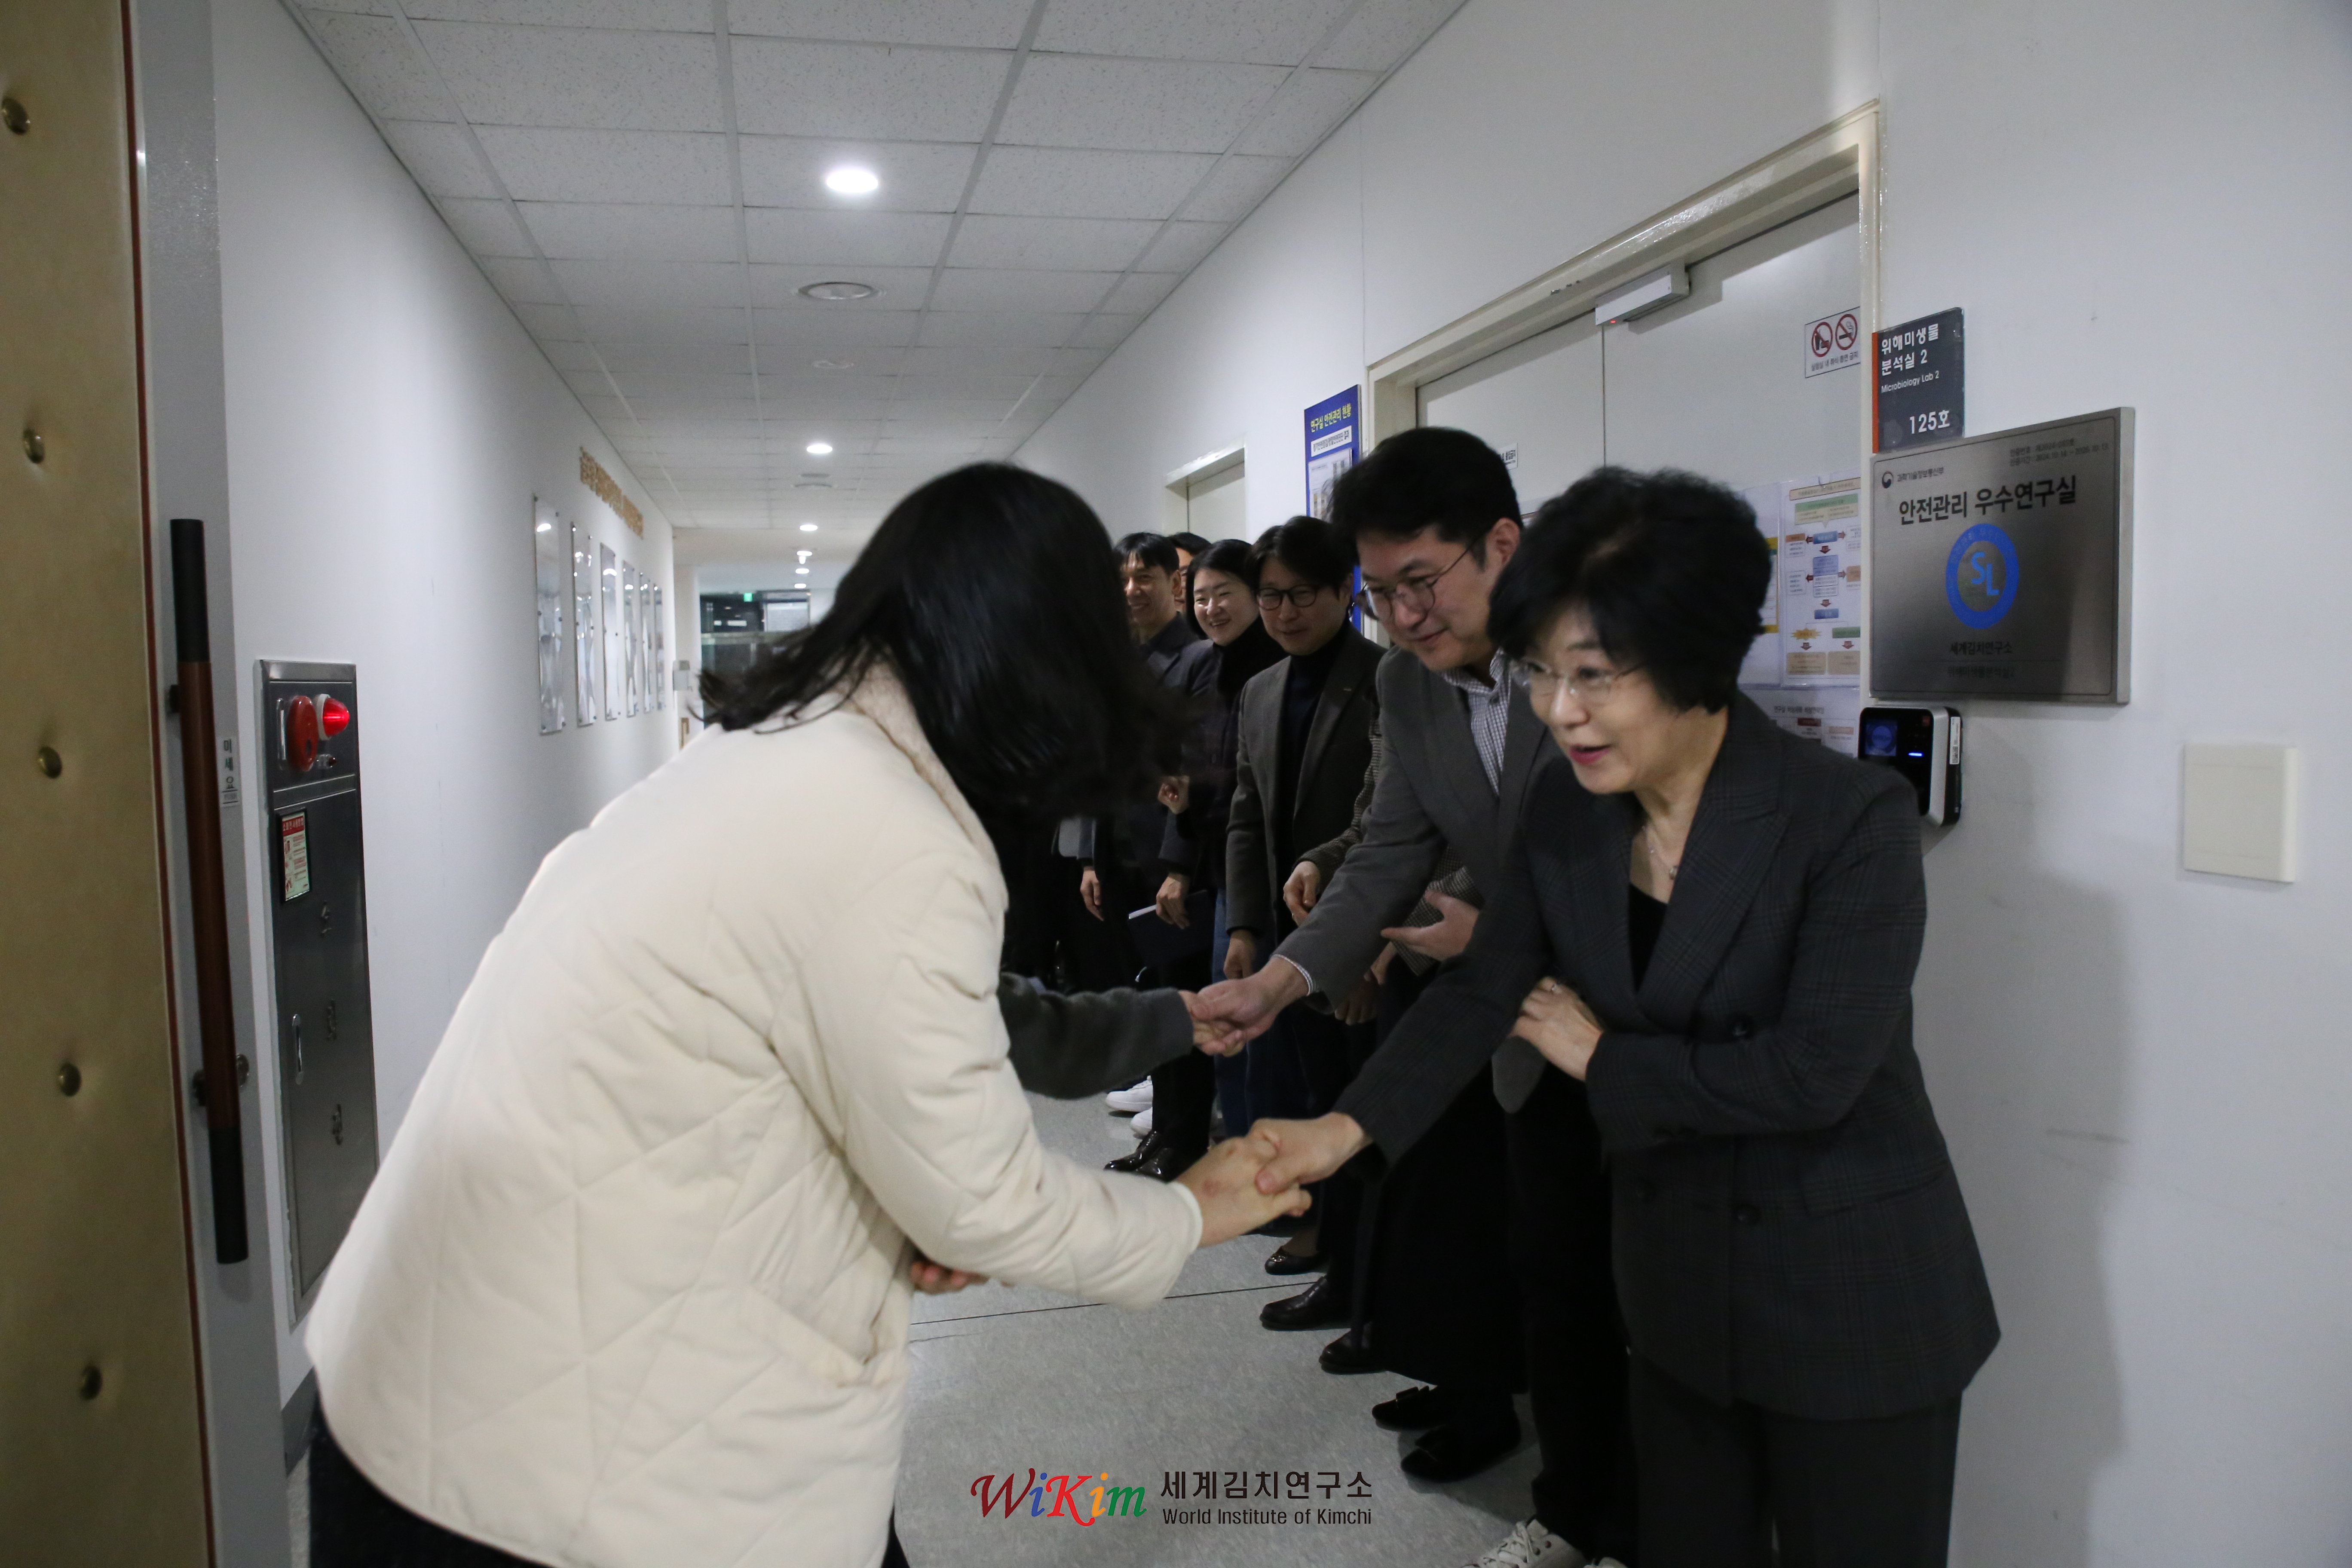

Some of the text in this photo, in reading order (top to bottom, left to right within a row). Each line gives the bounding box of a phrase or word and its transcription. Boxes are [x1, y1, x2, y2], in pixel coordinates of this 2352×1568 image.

[1881, 323, 1939, 355] 위해미생물
[1882, 349, 1928, 376] 분석실 2
[1881, 370, 1939, 393] Microbiology Lab 2
[1311, 403, 1352, 432] 연구실 안전관리 현황
[1910, 410, 1950, 434] 125호
[1899, 475, 2076, 525] 안전관리 우수연구실
[1950, 641, 2013, 655] 세계김치연구소
